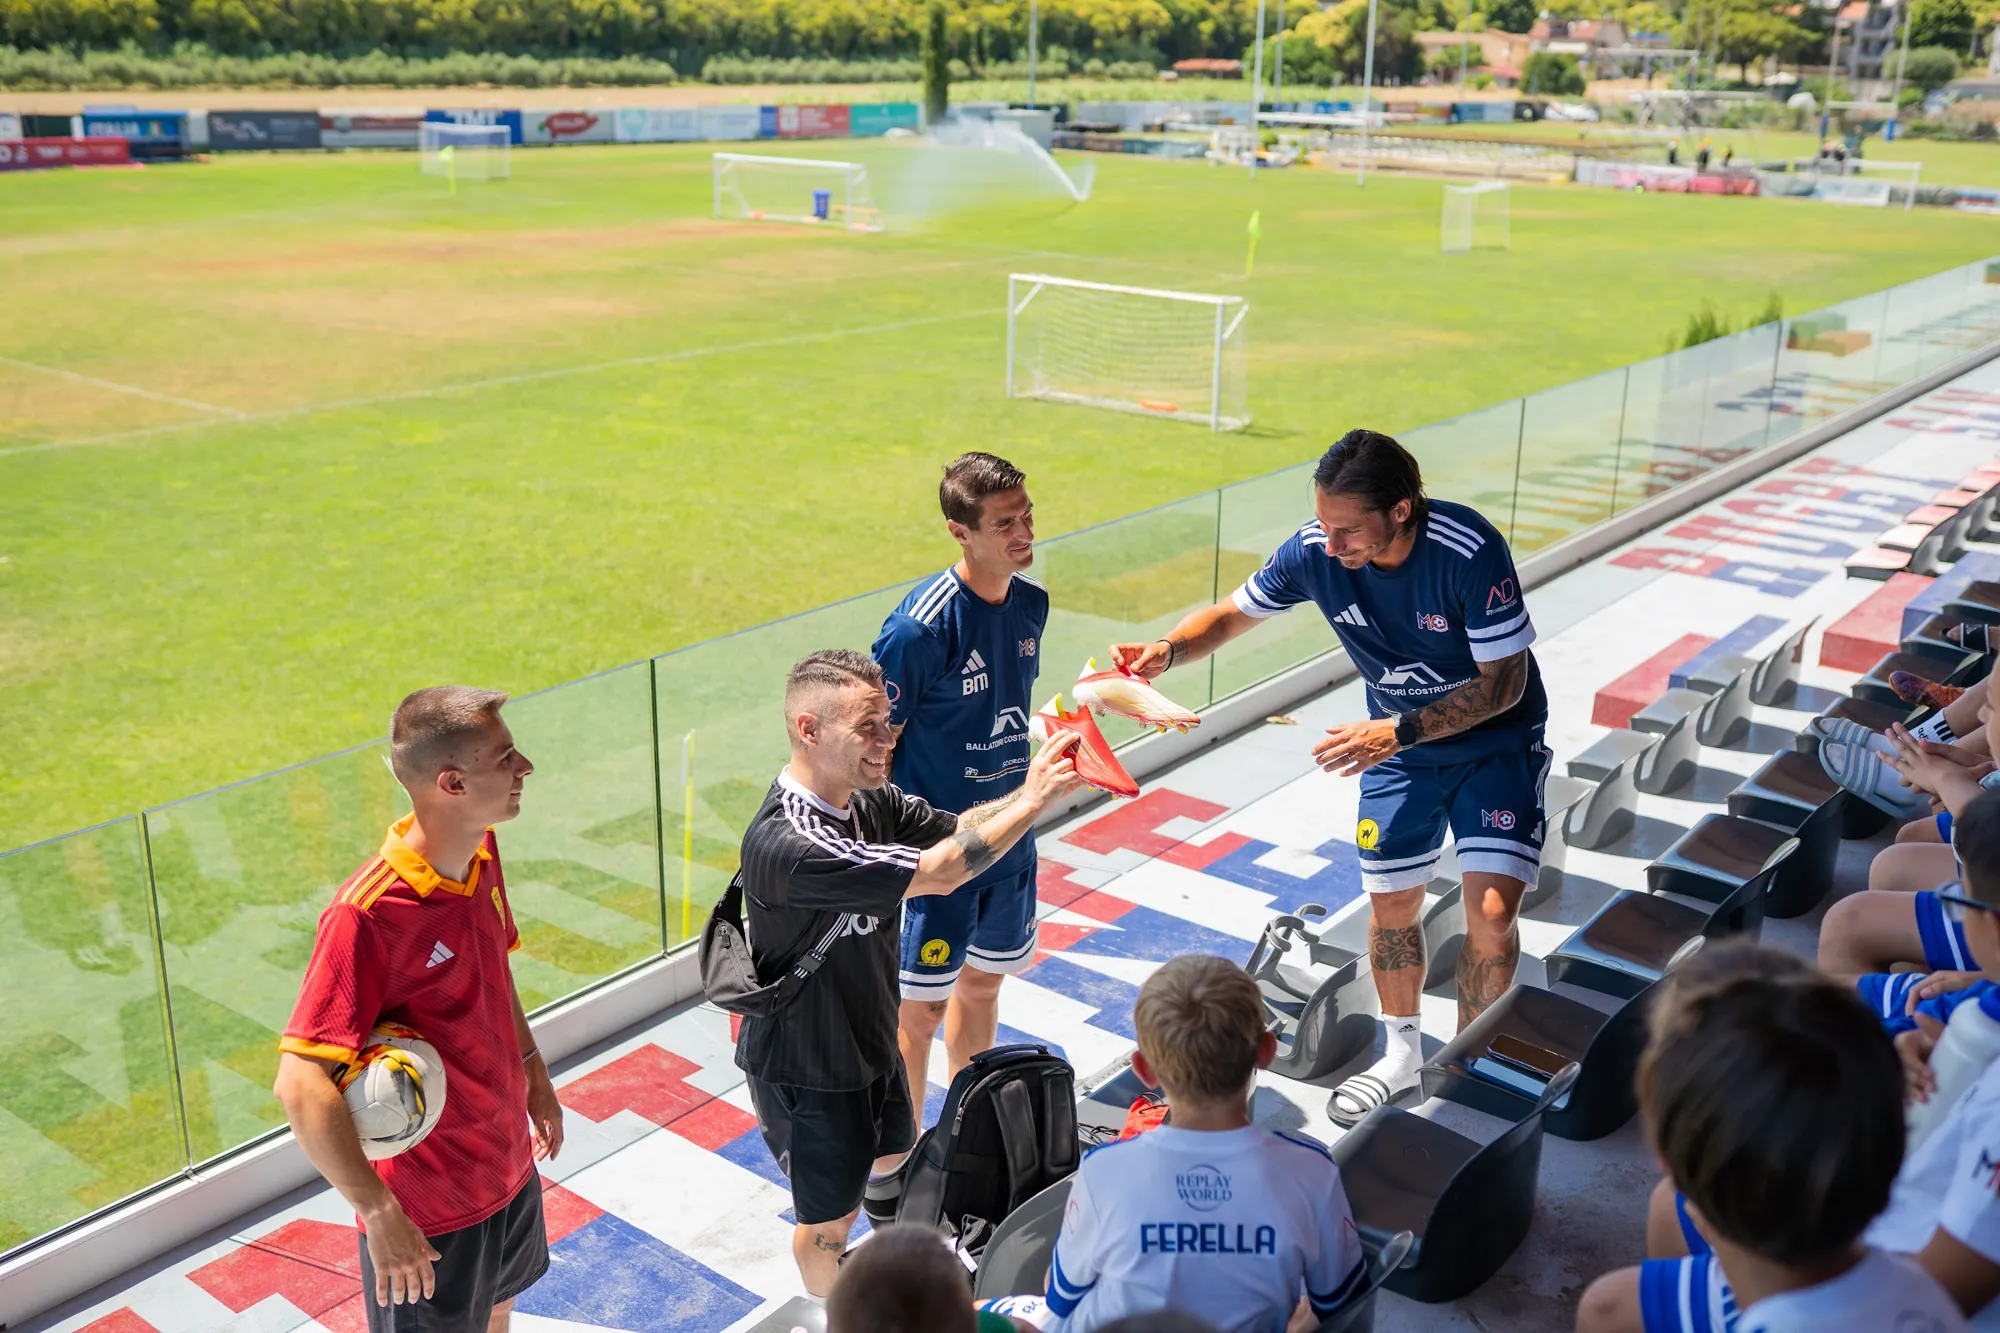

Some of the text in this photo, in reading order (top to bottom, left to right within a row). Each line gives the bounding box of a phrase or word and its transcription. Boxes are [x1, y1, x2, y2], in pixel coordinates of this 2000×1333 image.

[1408, 677, 1472, 697] COSTRUZIONI
[965, 732, 1028, 751] BALLATORI COSTR
[1176, 1173, 1232, 1189] REPLAY
[1177, 1188, 1233, 1202] WORLD
[1141, 1222, 1276, 1255] FERELLA
